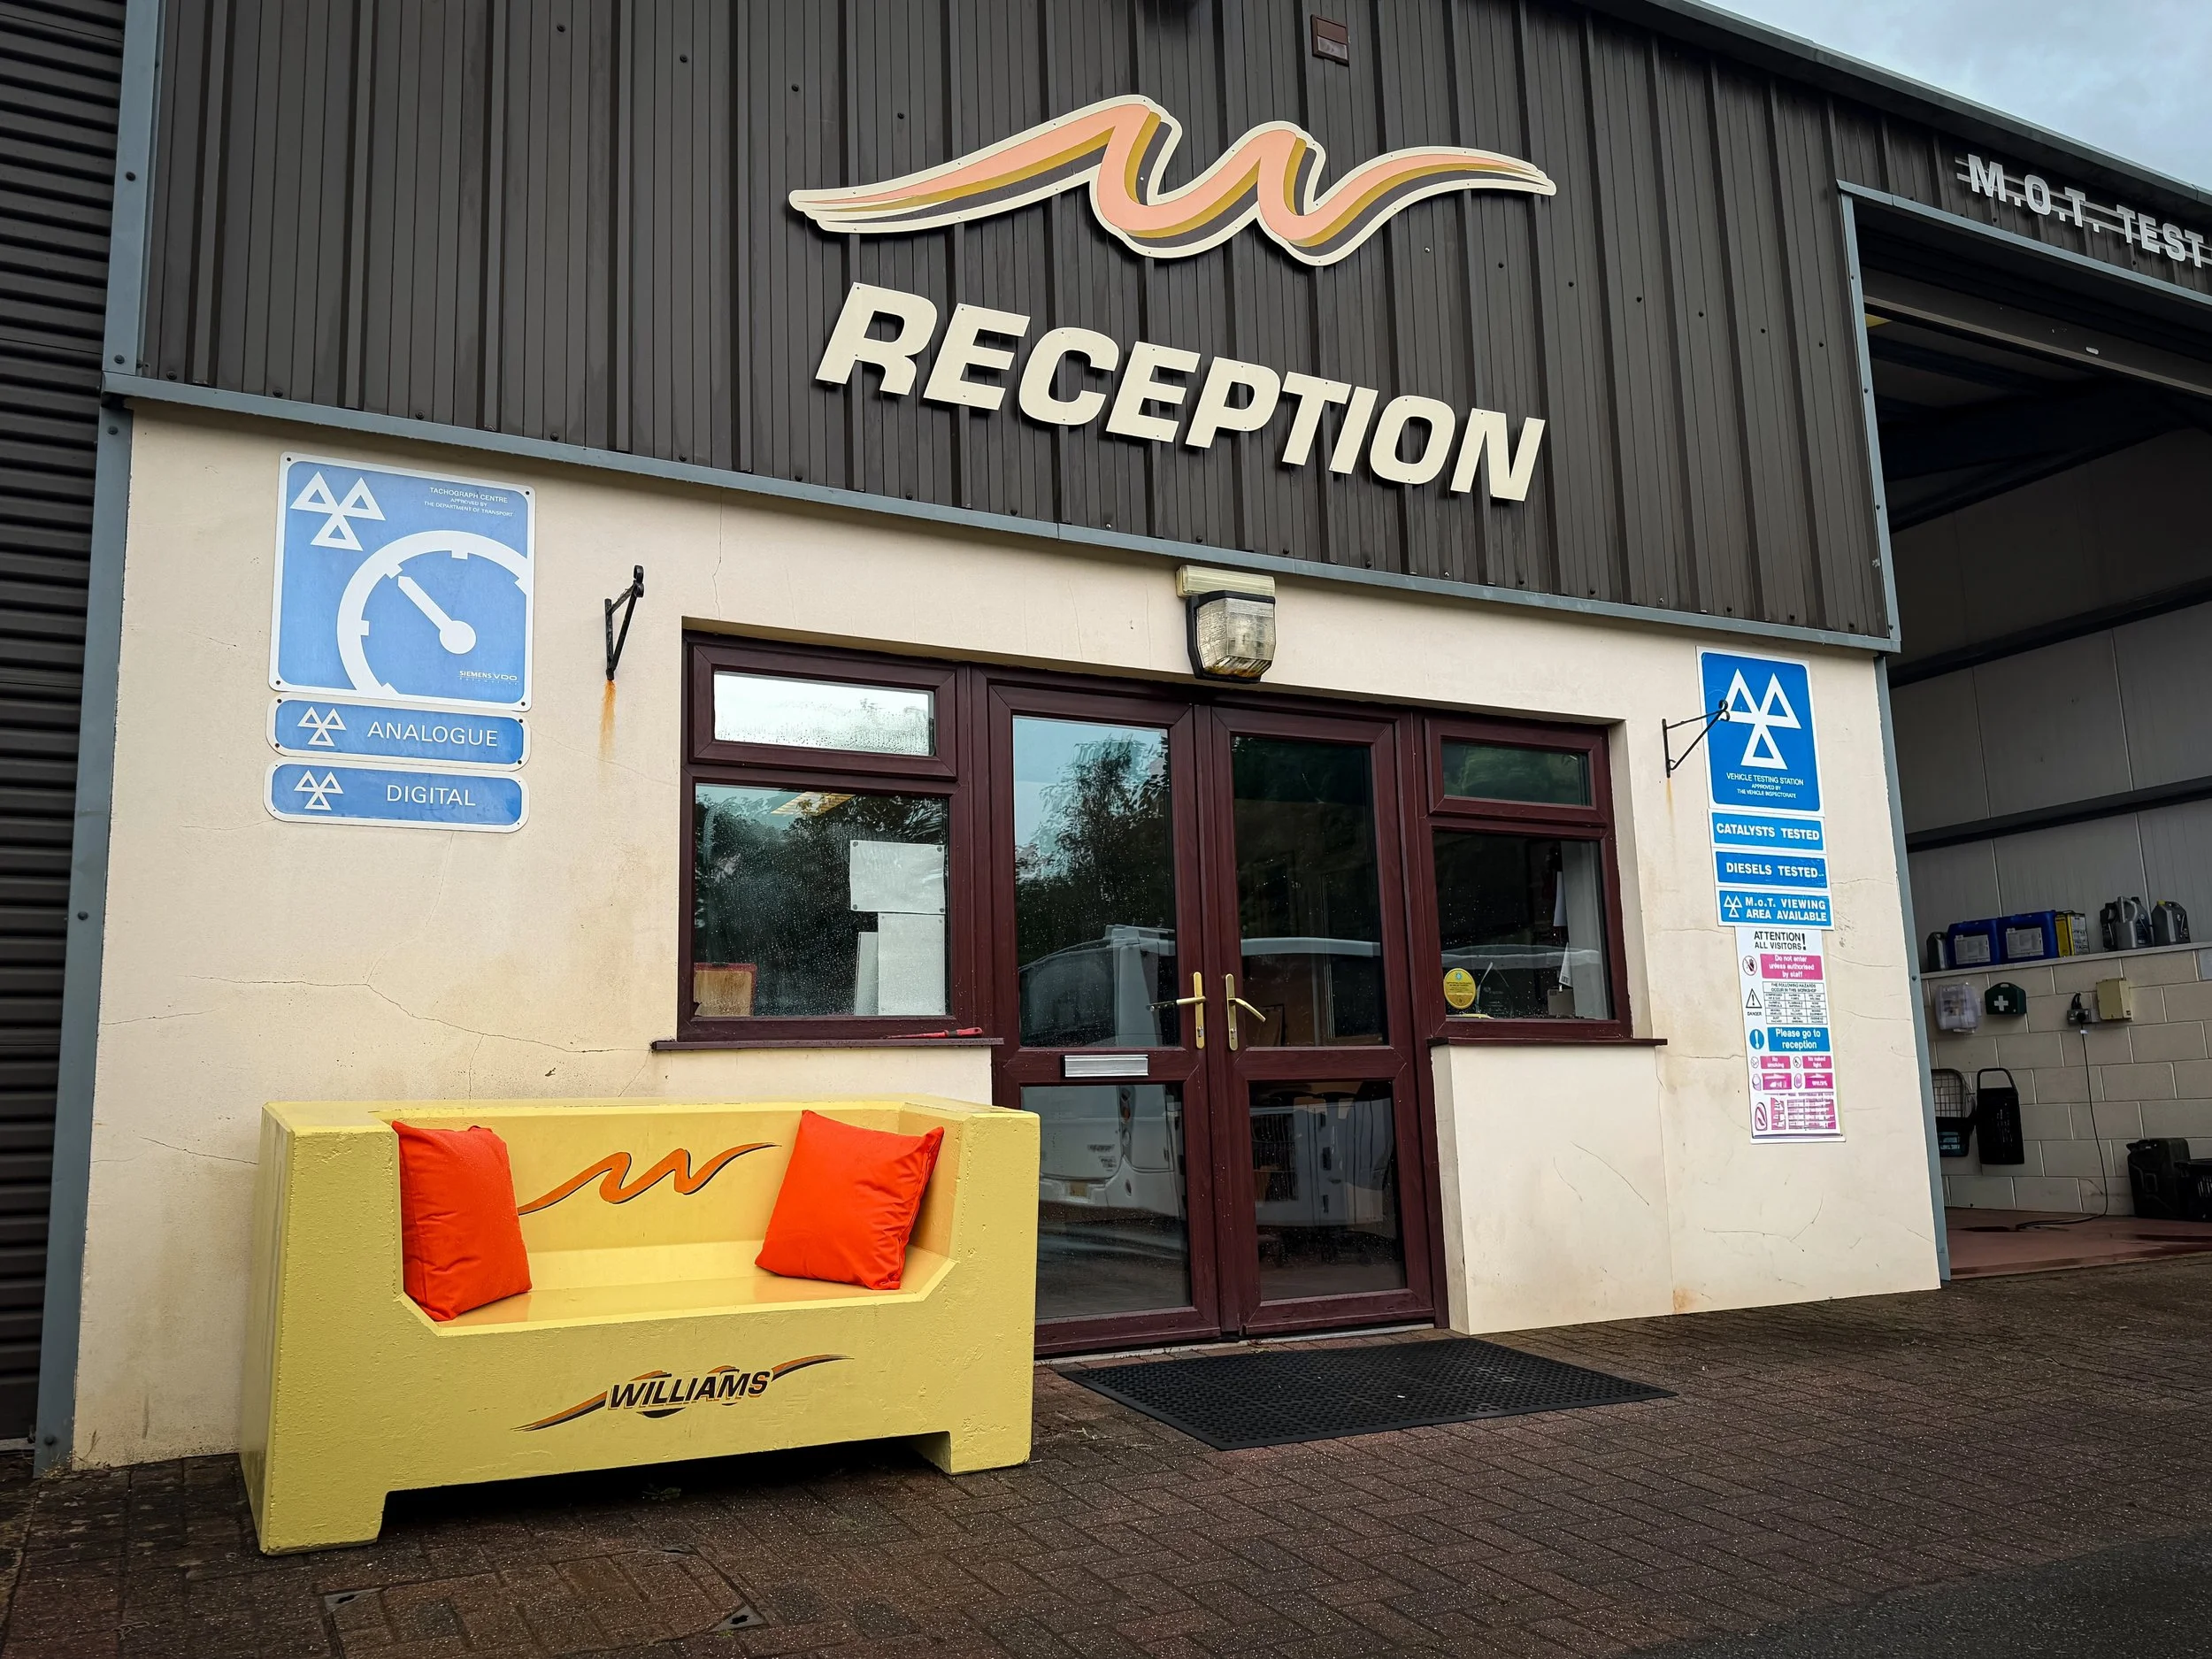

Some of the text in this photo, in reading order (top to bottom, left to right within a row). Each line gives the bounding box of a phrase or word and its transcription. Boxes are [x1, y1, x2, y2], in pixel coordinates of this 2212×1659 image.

[1967, 153, 2204, 269] M.O.T. TEST
[815, 281, 1547, 502] RECEPTION
[429, 487, 509, 503] TACHOGRAPH CENTRE
[435, 502, 472, 511] DEPARTMENT
[481, 508, 513, 517] TRANSPORT
[459, 670, 492, 679] SIEMENS
[366, 721, 498, 747] ANALOGUE
[1725, 772, 1804, 786] VEHICLE TESTING STATION
[386, 784, 476, 808] DIGITAL
[1765, 790, 1797, 799] INSPECTORATE
[1716, 823, 1820, 841] CATALYSTS TESTED
[1725, 862, 1818, 878] DIESELS TESTED
[1745, 896, 1826, 910] M.o.T. VIEWING
[1746, 909, 1827, 921] AREA AVAILABLE
[1754, 931, 1801, 941] ATTENTION
[1770, 941, 1801, 950] VISITORS
[1775, 1028, 1821, 1040] Please go to
[1782, 1040, 1817, 1050] reception
[608, 1371, 771, 1409] WILLIAMS
